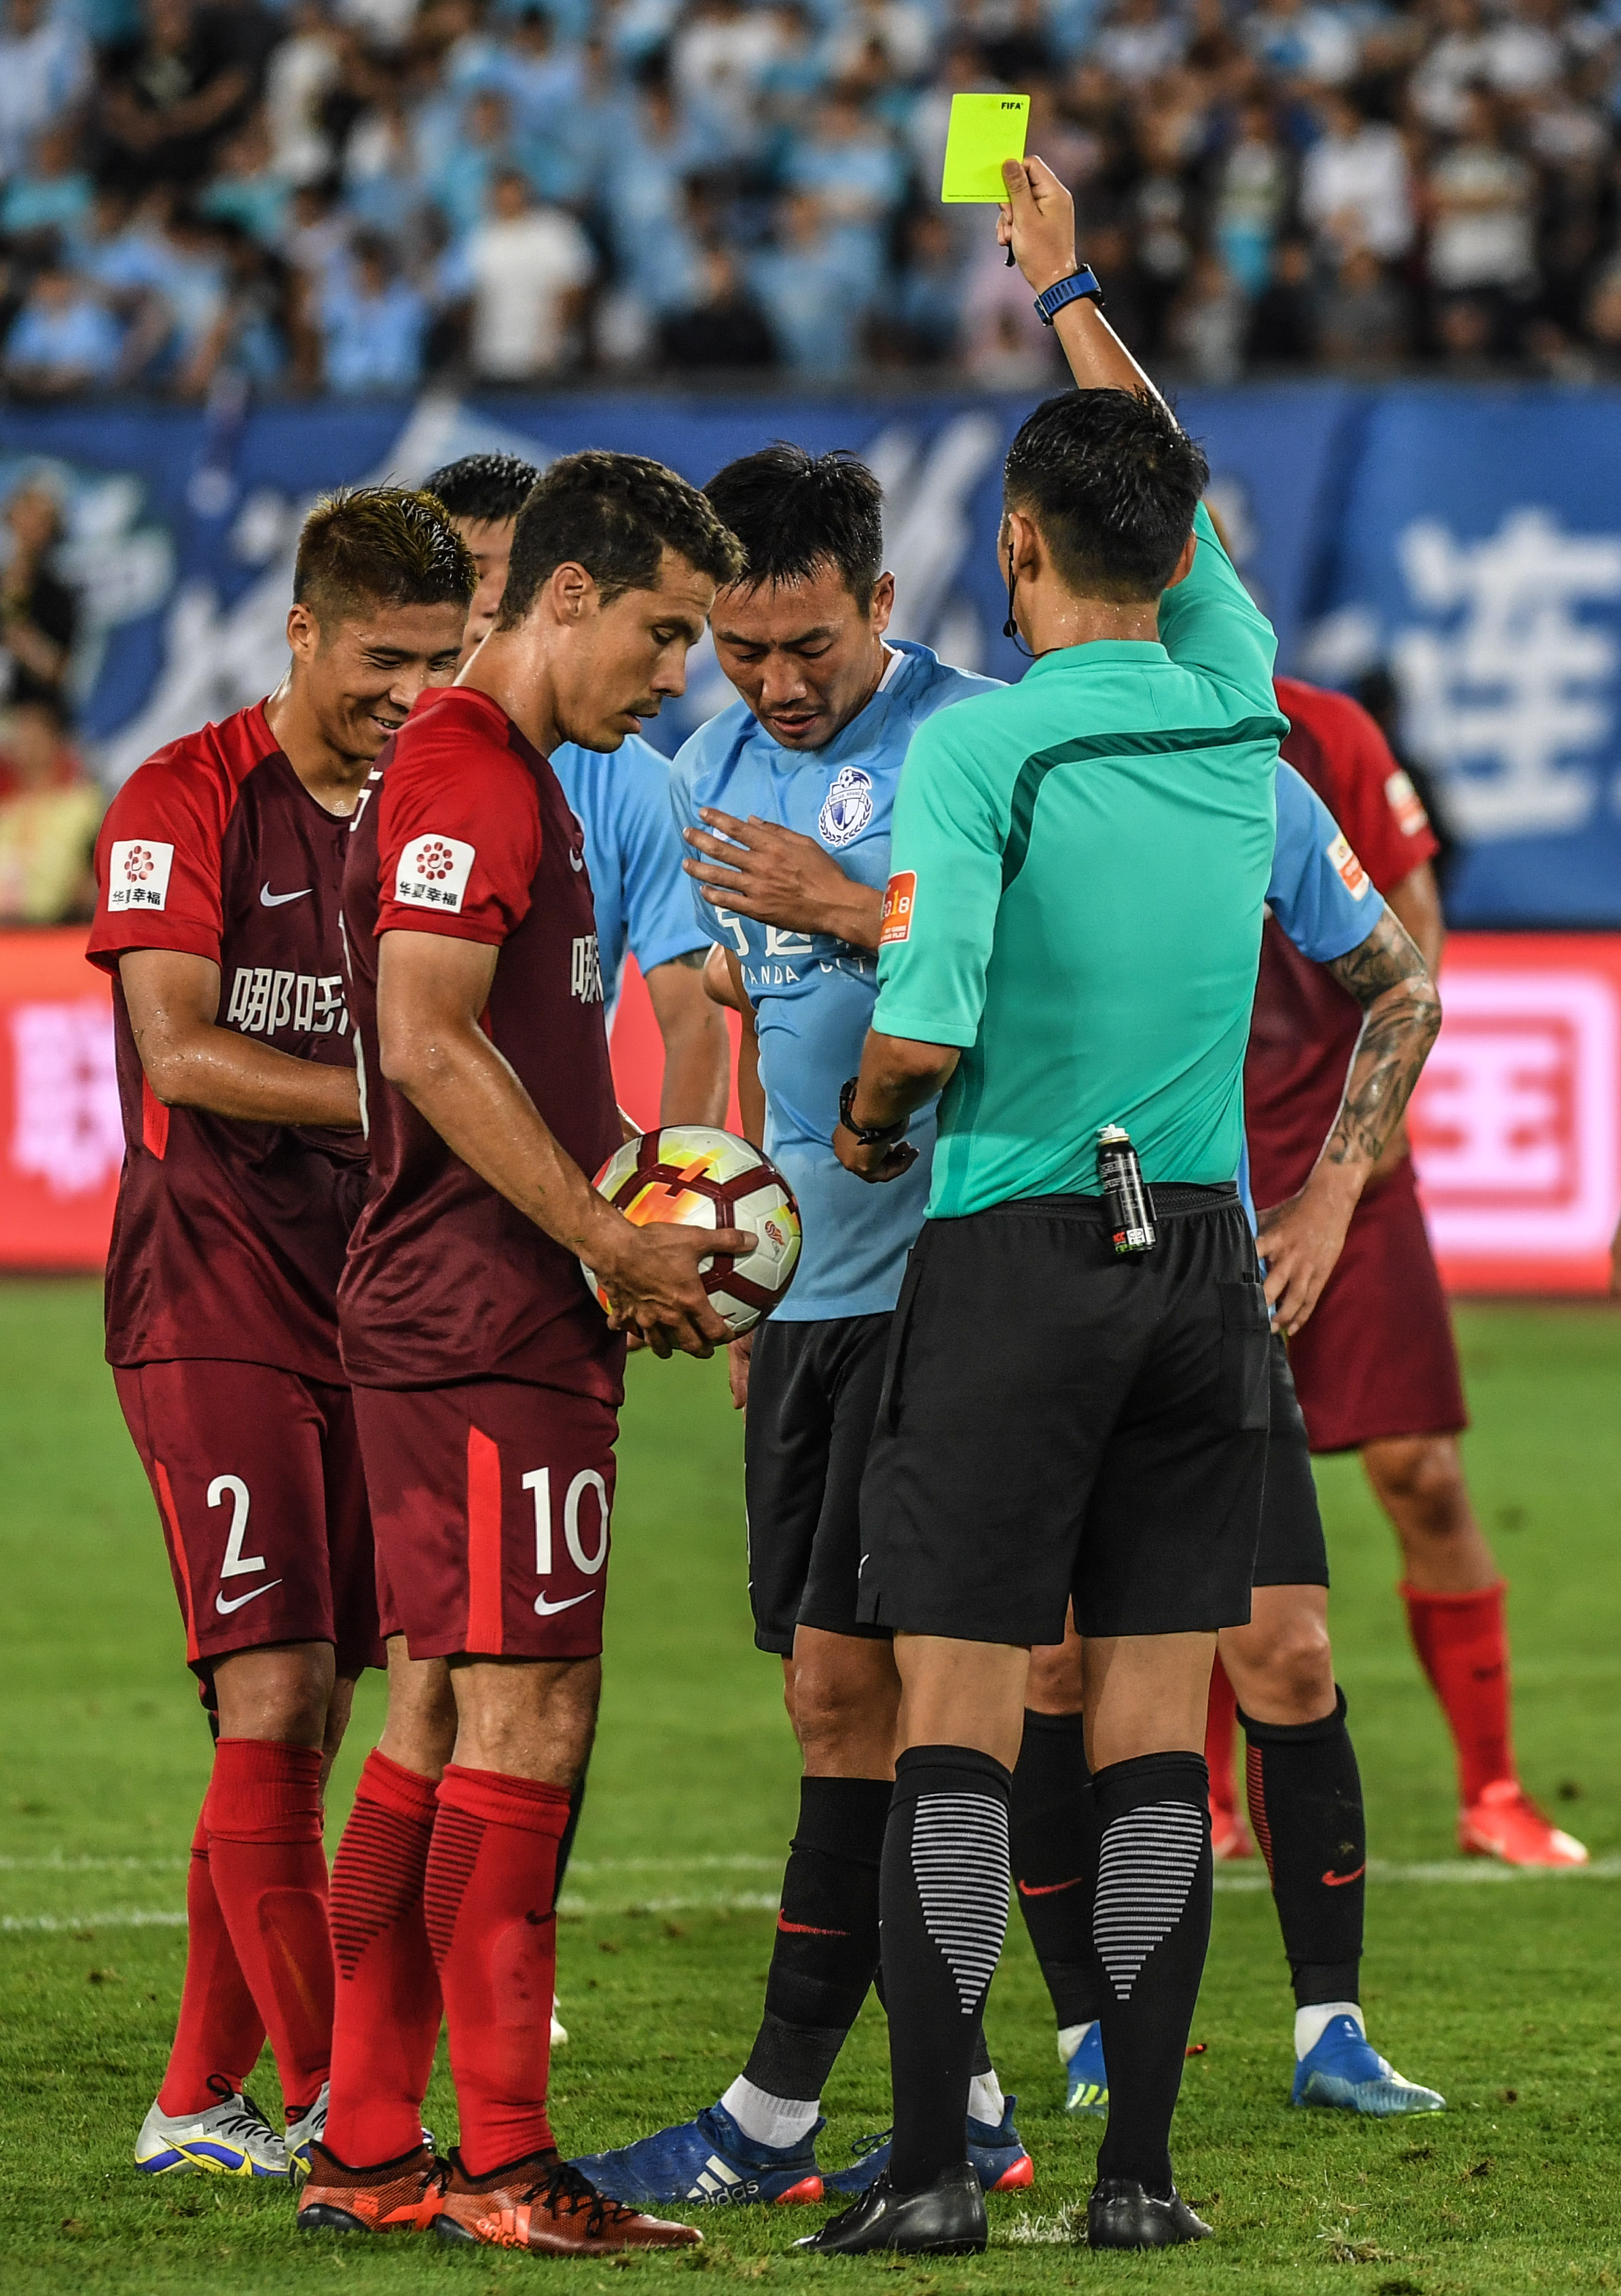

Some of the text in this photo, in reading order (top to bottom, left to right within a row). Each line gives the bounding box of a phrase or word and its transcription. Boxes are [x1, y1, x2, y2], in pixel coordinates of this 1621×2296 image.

[1001, 102, 1021, 110] FIFA
[399, 881, 458, 906] 华夏幸福
[226, 967, 350, 1036] 哪吒
[206, 1473, 268, 1579] 2
[522, 1466, 610, 1576] 10
[697, 2179, 759, 2206] didas
